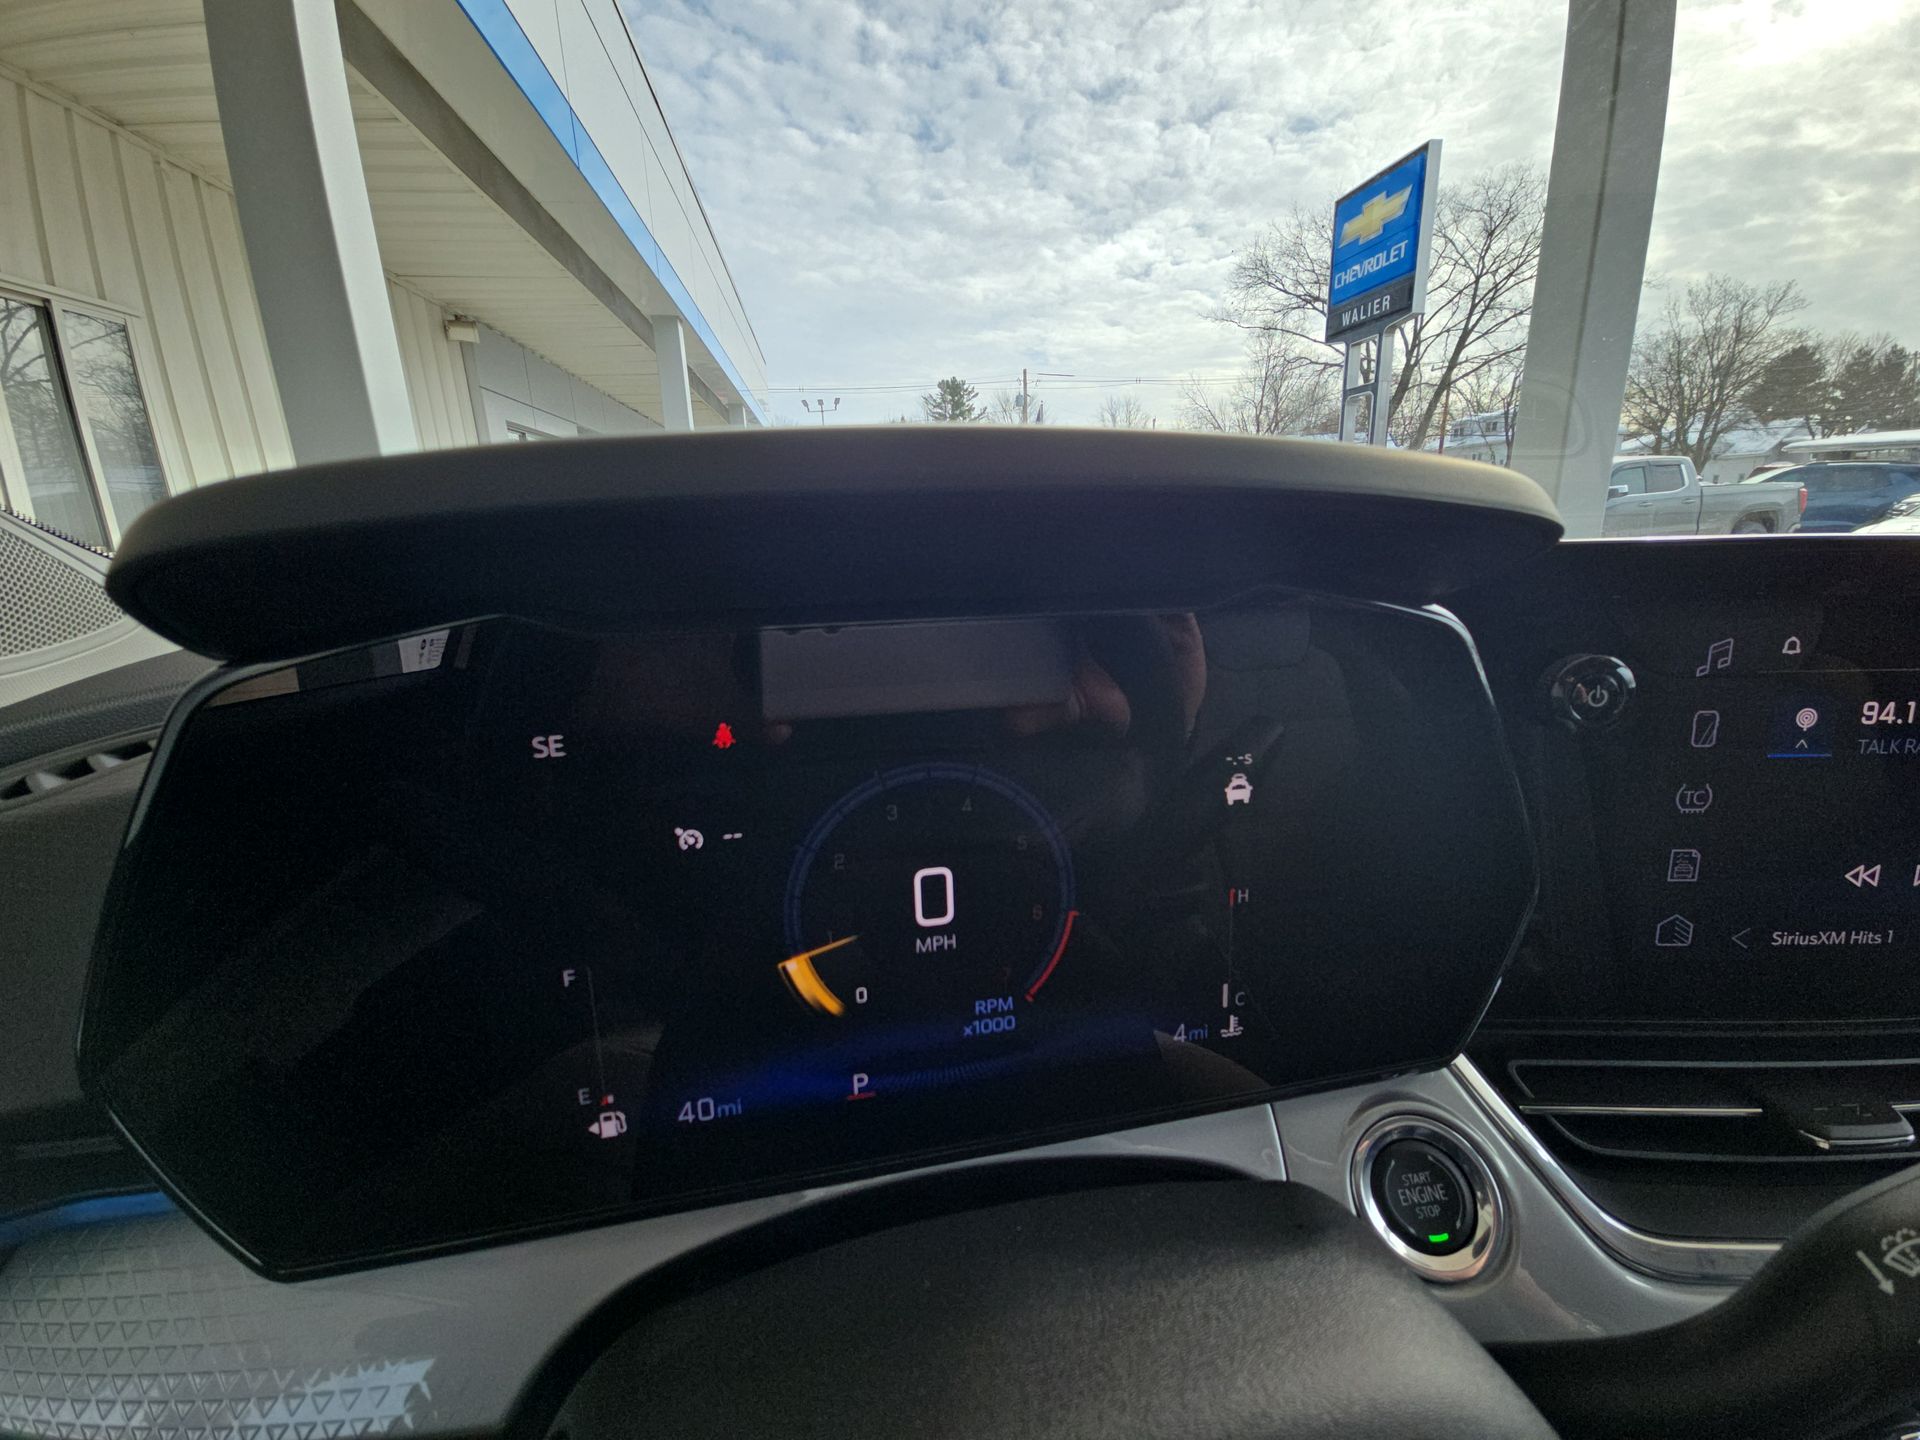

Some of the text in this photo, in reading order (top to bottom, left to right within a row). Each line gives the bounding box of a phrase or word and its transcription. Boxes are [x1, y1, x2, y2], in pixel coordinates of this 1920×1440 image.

[1334, 240, 1408, 290] CHEVROLET
[1341, 295, 1391, 327] WALIER
[1861, 701, 1916, 725] 94.1
[531, 734, 567, 759] SE
[1858, 738, 1901, 755] TALK
[886, 804, 898, 821] 3
[961, 798, 973, 812] 4
[833, 854, 845, 870] 2
[913, 866, 955, 928] 0
[1237, 888, 1249, 903] H
[915, 933, 957, 954] MPH
[1771, 930, 1894, 947] SiriusXM Hits 1
[562, 969, 576, 987] F
[855, 986, 868, 1004] 0
[1235, 991, 1246, 1006] C
[974, 996, 1014, 1015] RPM
[963, 1015, 1016, 1037] x1000
[852, 1072, 869, 1096] P
[577, 1087, 592, 1105] E
[1401, 1171, 1431, 1186] START
[1398, 1184, 1448, 1206] ENGINE
[1415, 1204, 1441, 1219] STOP
